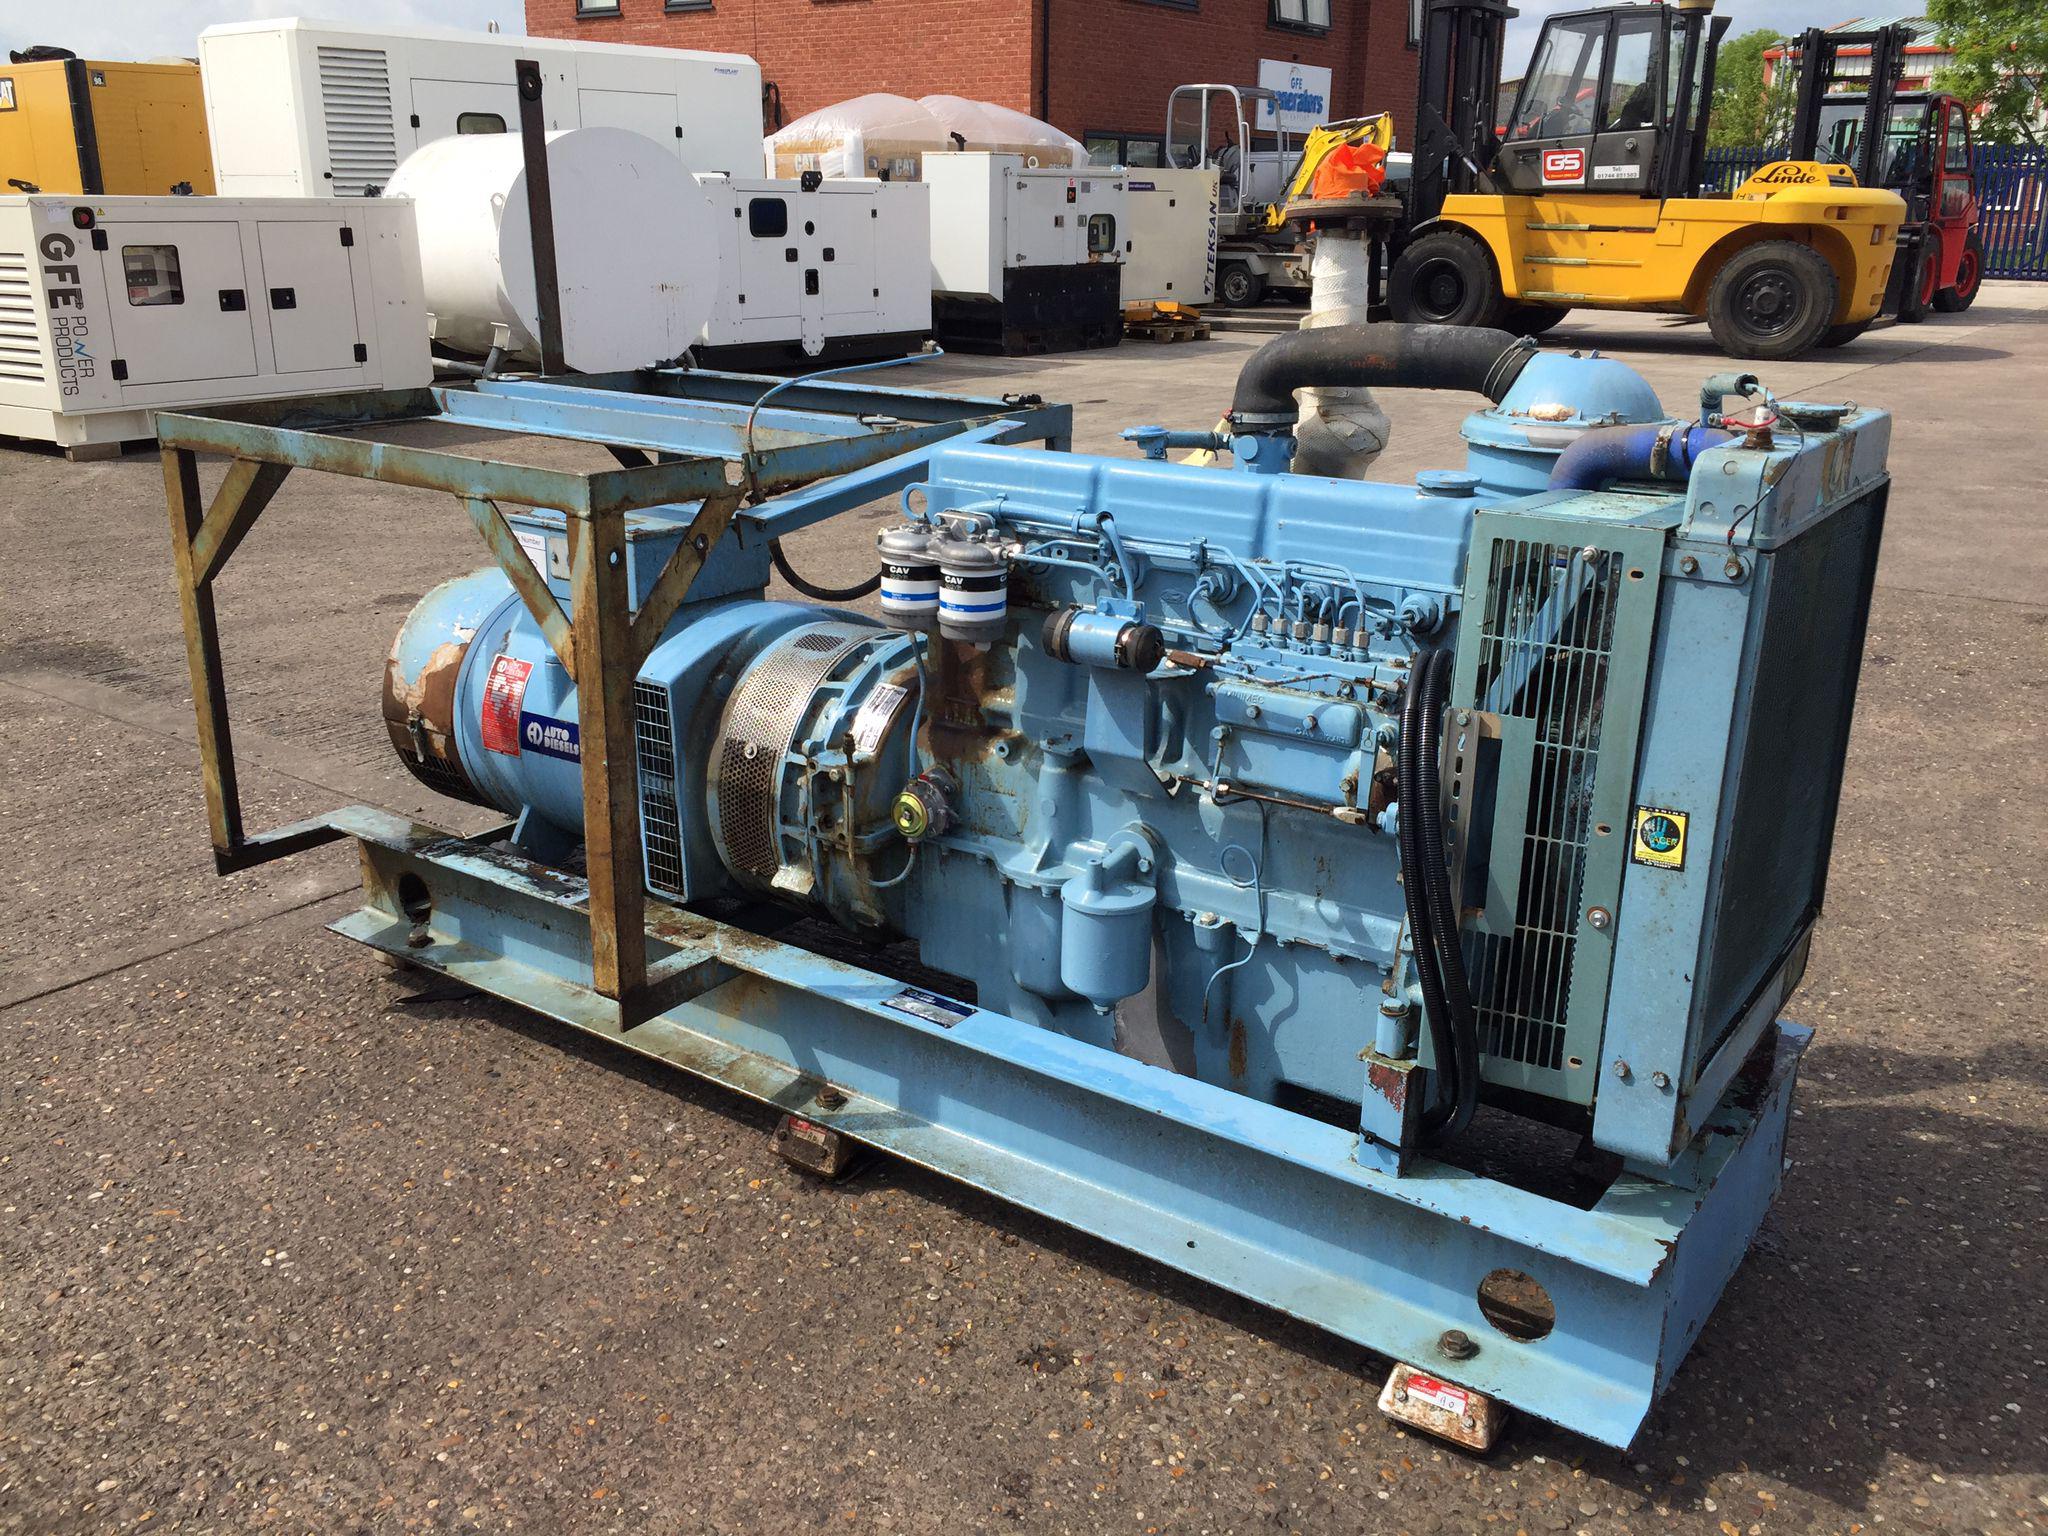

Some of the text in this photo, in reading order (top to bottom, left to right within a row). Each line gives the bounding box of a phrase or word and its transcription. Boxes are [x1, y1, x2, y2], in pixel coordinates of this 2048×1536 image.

[1291, 77, 1303, 90] GFE
[0, 80, 15, 108] AT
[895, 158, 915, 177] CAT
[1546, 153, 1580, 171] GS
[1753, 164, 1820, 184] Linde
[1207, 180, 1218, 274] TEKSAN UK
[40, 233, 84, 309] GFE
[52, 317, 79, 396] PRODUCTS
[71, 316, 97, 378] POWER
[889, 566, 909, 575] CAV
[944, 575, 963, 585] CAV
[544, 725, 570, 741] AUTO
[544, 736, 579, 756] DIESELS
[1640, 806, 1686, 816] WARNING
